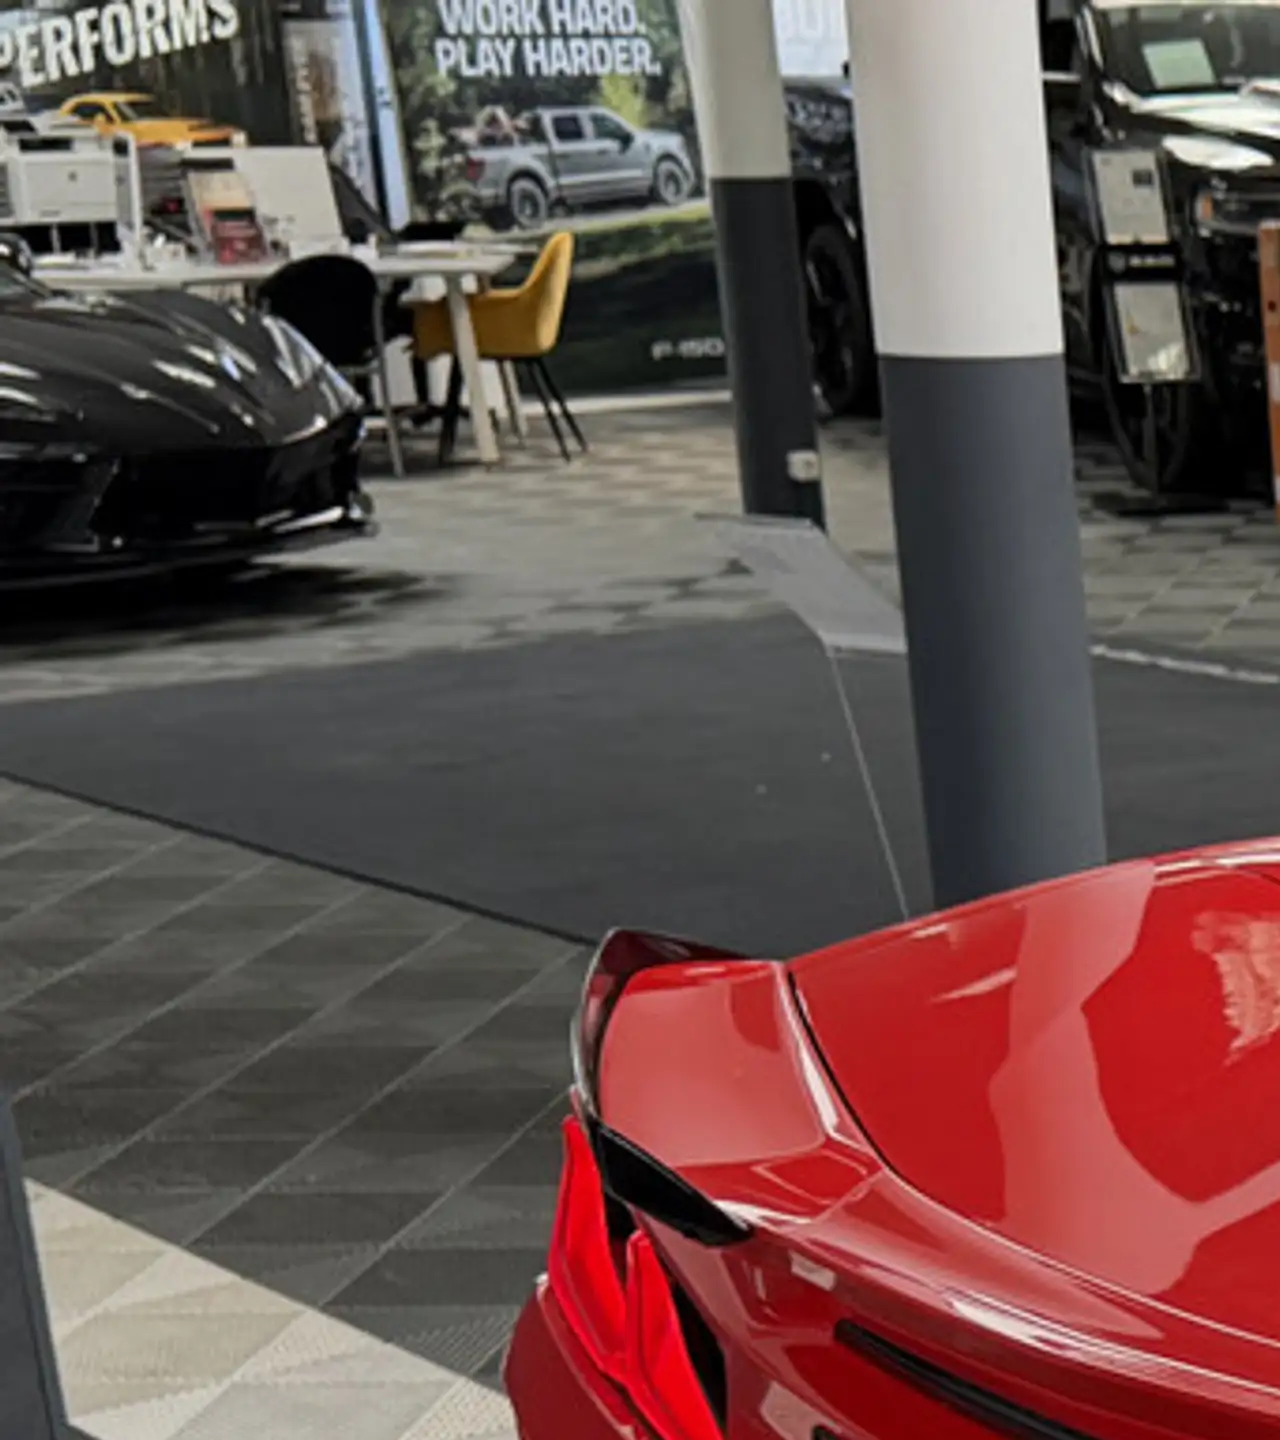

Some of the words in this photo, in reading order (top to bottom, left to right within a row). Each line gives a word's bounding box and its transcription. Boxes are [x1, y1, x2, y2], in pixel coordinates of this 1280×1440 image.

[437, 0, 545, 35] WORK
[550, 0, 647, 35] HARD.
[0, 0, 240, 88] PERFORMS
[435, 37, 517, 77] PLAY
[522, 37, 662, 77] HARDER.
